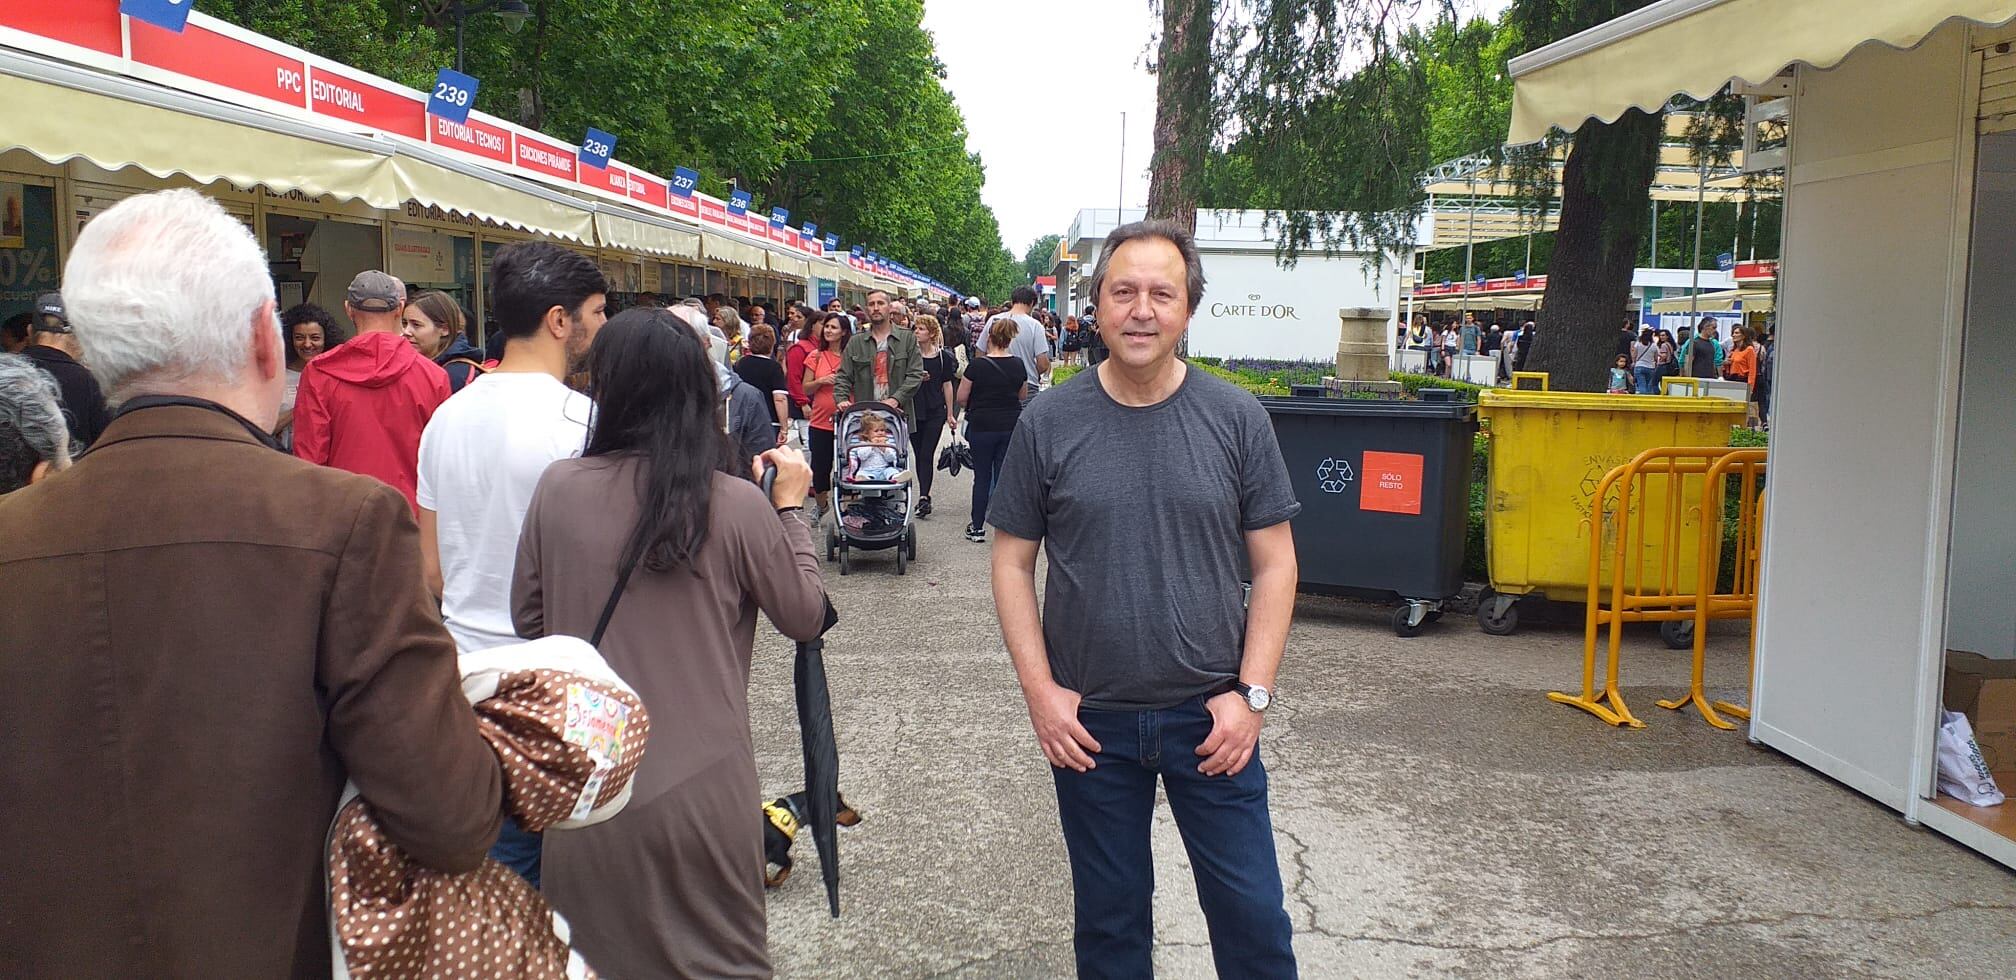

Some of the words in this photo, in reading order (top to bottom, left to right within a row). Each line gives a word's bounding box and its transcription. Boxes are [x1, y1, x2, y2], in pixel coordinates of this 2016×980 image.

[277, 67, 301, 93] PPC
[312, 79, 364, 112] EDITORIAL
[435, 83, 468, 106] 239
[438, 119, 474, 145] EDITORIAL
[475, 129, 502, 151] TECNOS
[584, 139, 609, 157] 238
[519, 144, 548, 166] EDICIONES
[674, 176, 693, 189] 237
[730, 197, 746, 208] 236
[772, 213, 785, 223] 235
[802, 226, 813, 236] 234
[1720, 258, 1733, 267] 254
[44, 305, 62, 313] NIKE
[1211, 302, 1257, 318] CARTE
[1261, 304, 1301, 320] D'OR
[1381, 472, 1402, 481] SÓLO
[1379, 481, 1403, 490] RESTO
